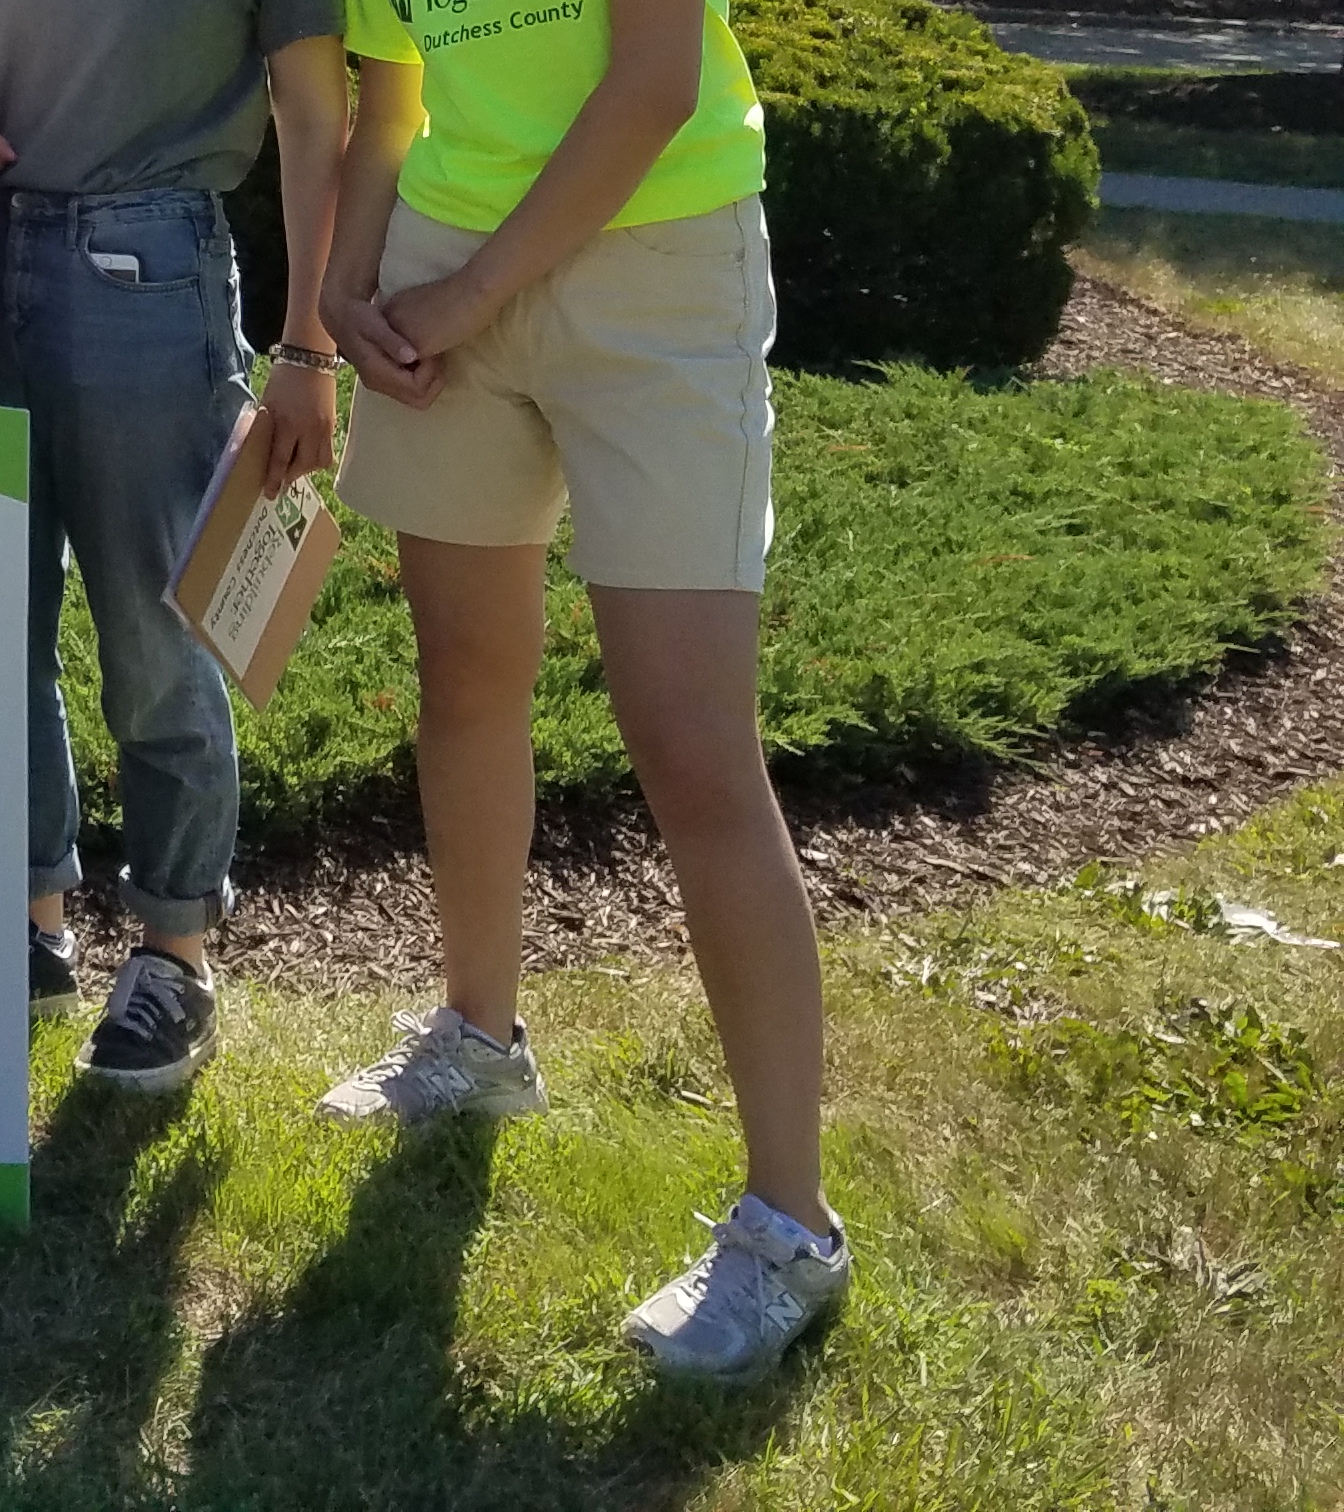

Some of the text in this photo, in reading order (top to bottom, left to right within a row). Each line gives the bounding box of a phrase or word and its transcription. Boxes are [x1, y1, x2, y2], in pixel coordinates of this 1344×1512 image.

[423, 0, 584, 53] Dutchess County
[210, 505, 269, 630] Dutchess County
